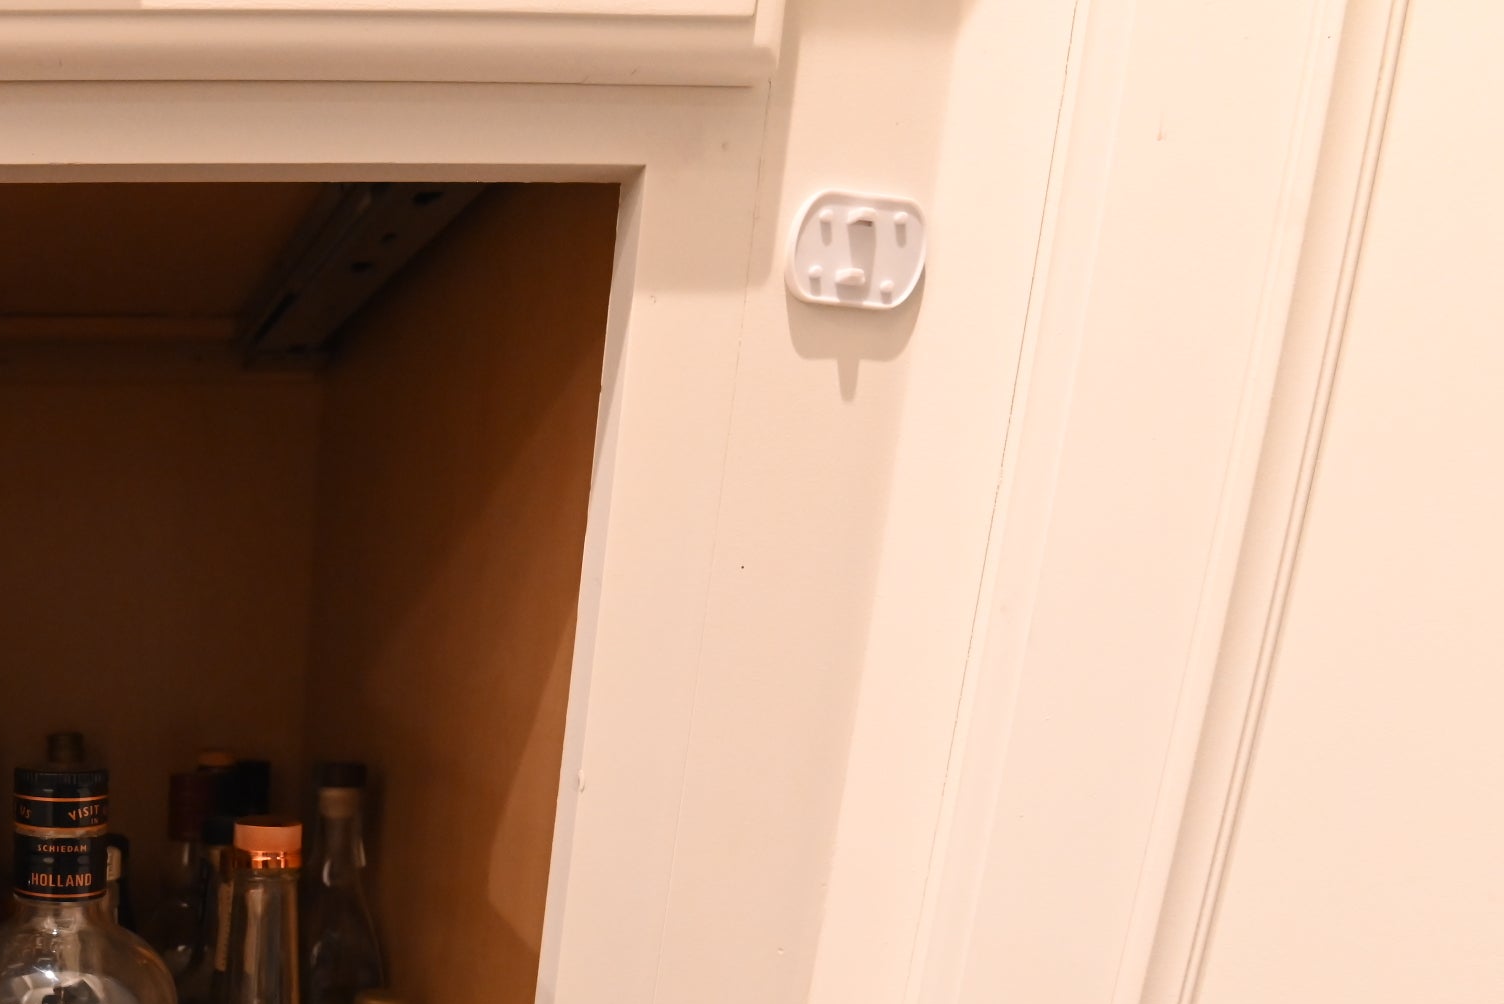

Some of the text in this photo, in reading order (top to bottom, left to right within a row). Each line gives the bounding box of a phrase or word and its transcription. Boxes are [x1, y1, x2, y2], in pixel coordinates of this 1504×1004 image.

[68, 804, 100, 821] VISIT
[37, 844, 87, 853] SCHIEDAM
[31, 872, 92, 888] HOLLAND
